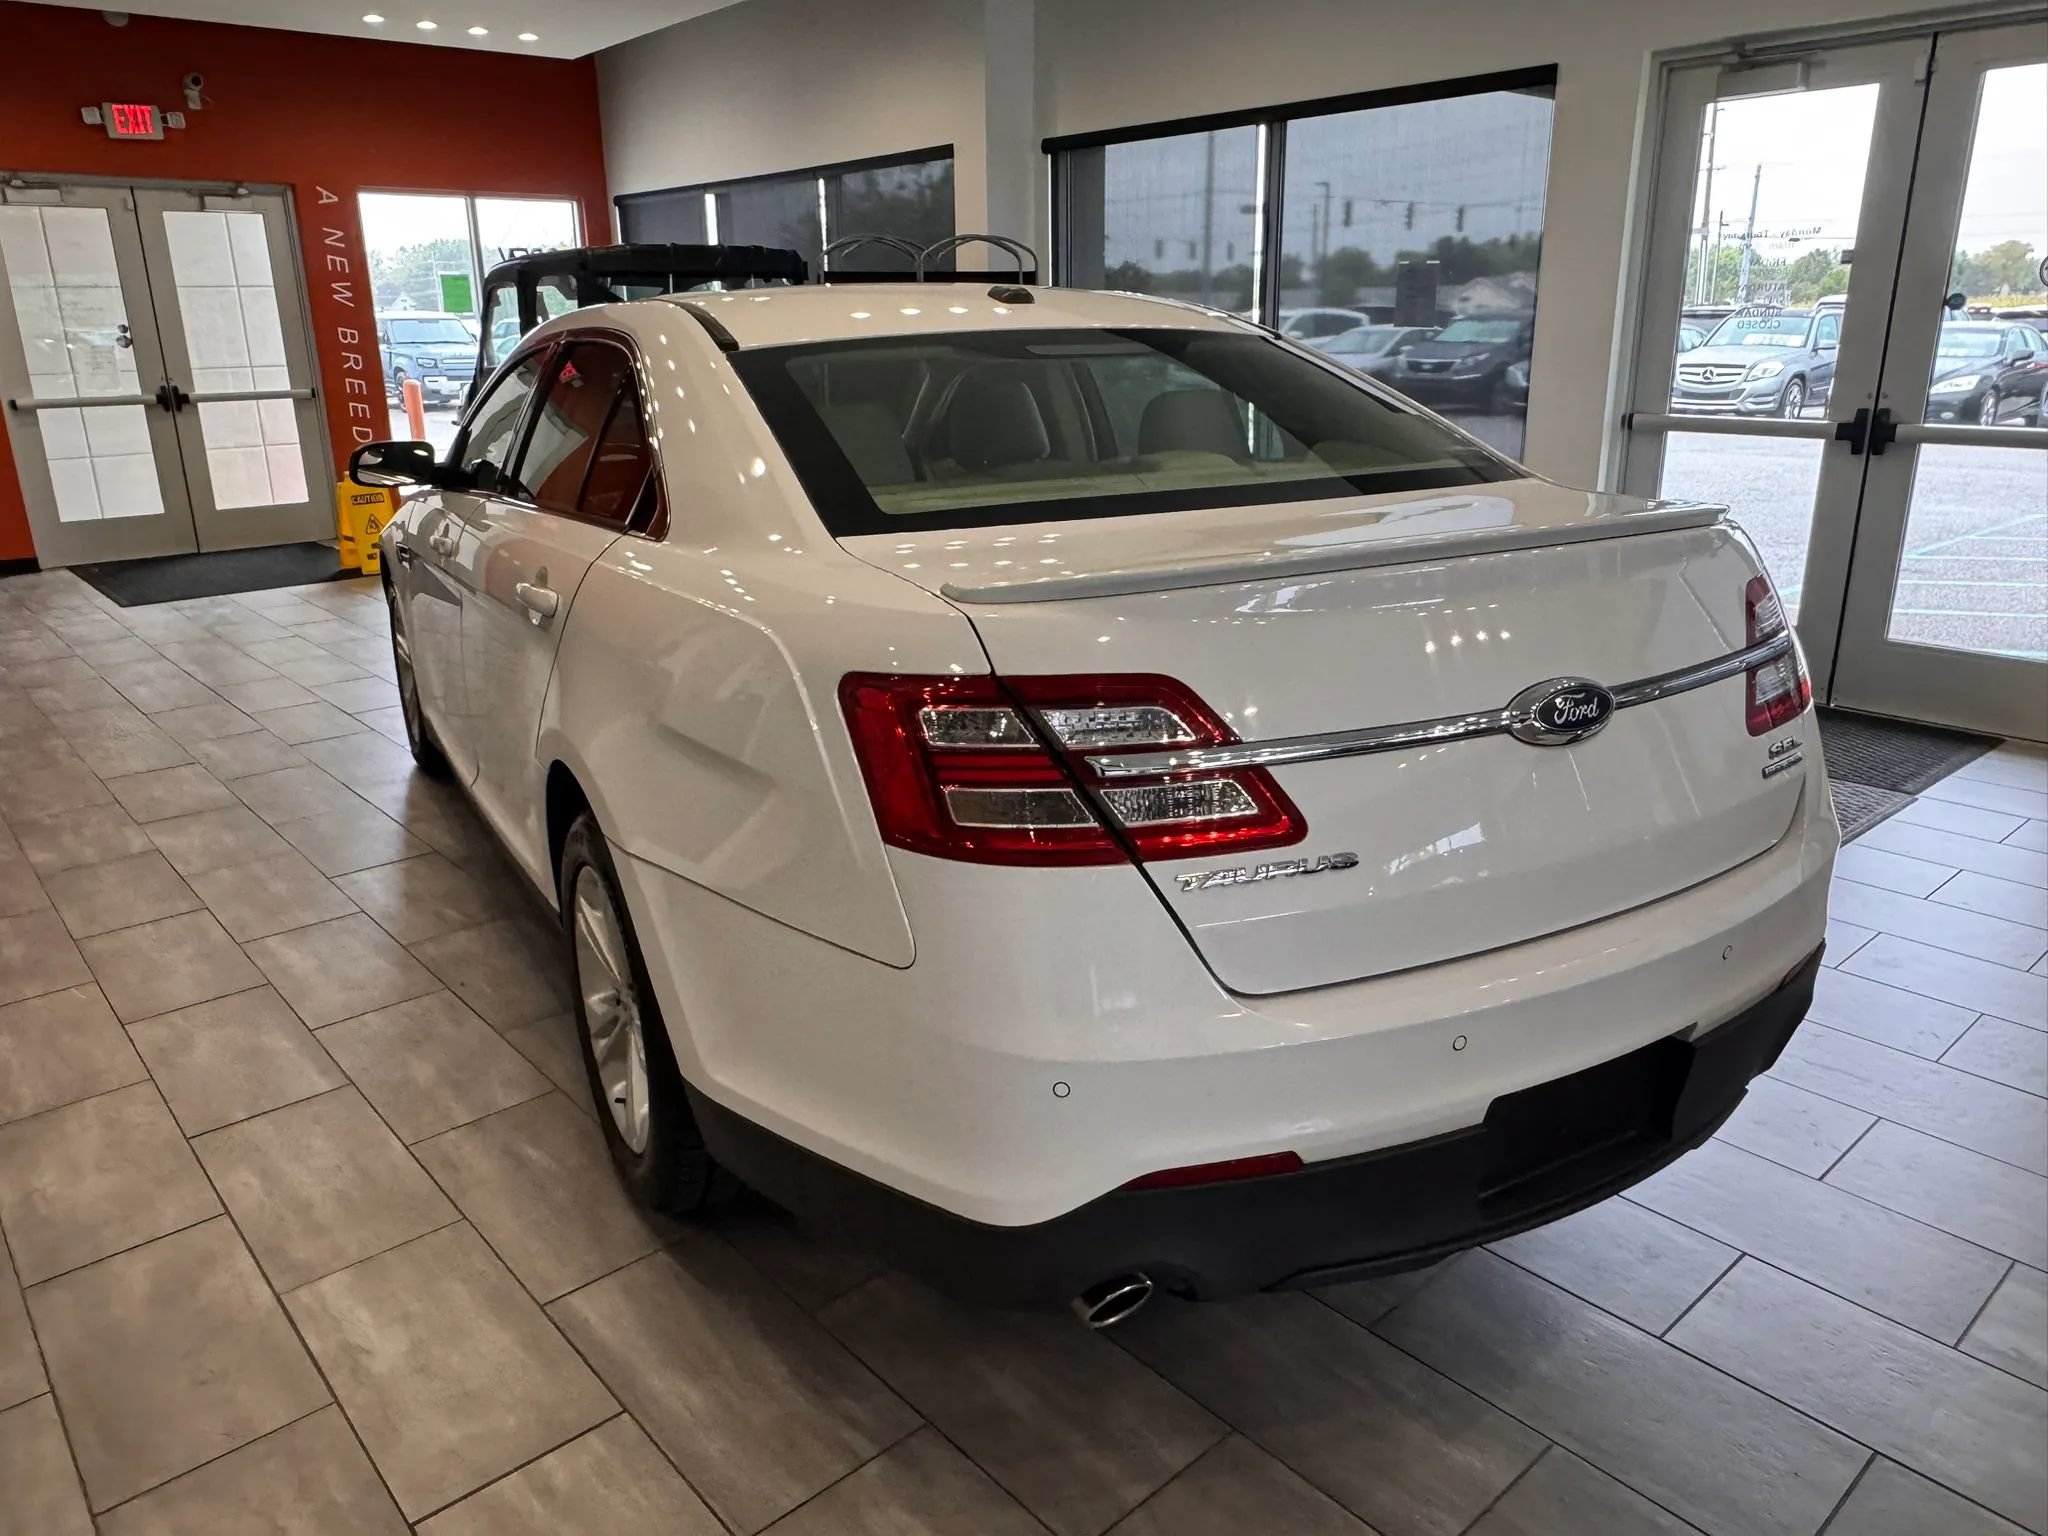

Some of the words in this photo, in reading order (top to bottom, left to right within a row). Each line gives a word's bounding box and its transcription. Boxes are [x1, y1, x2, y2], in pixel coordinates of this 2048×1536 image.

[111, 104, 154, 135] EXIT
[315, 185, 339, 204] A
[322, 227, 356, 308] NEW
[337, 326, 373, 443] BREED
[351, 493, 385, 505] CAUTION
[1554, 692, 1600, 725] Ford
[1175, 851, 1360, 892] TAURUS
